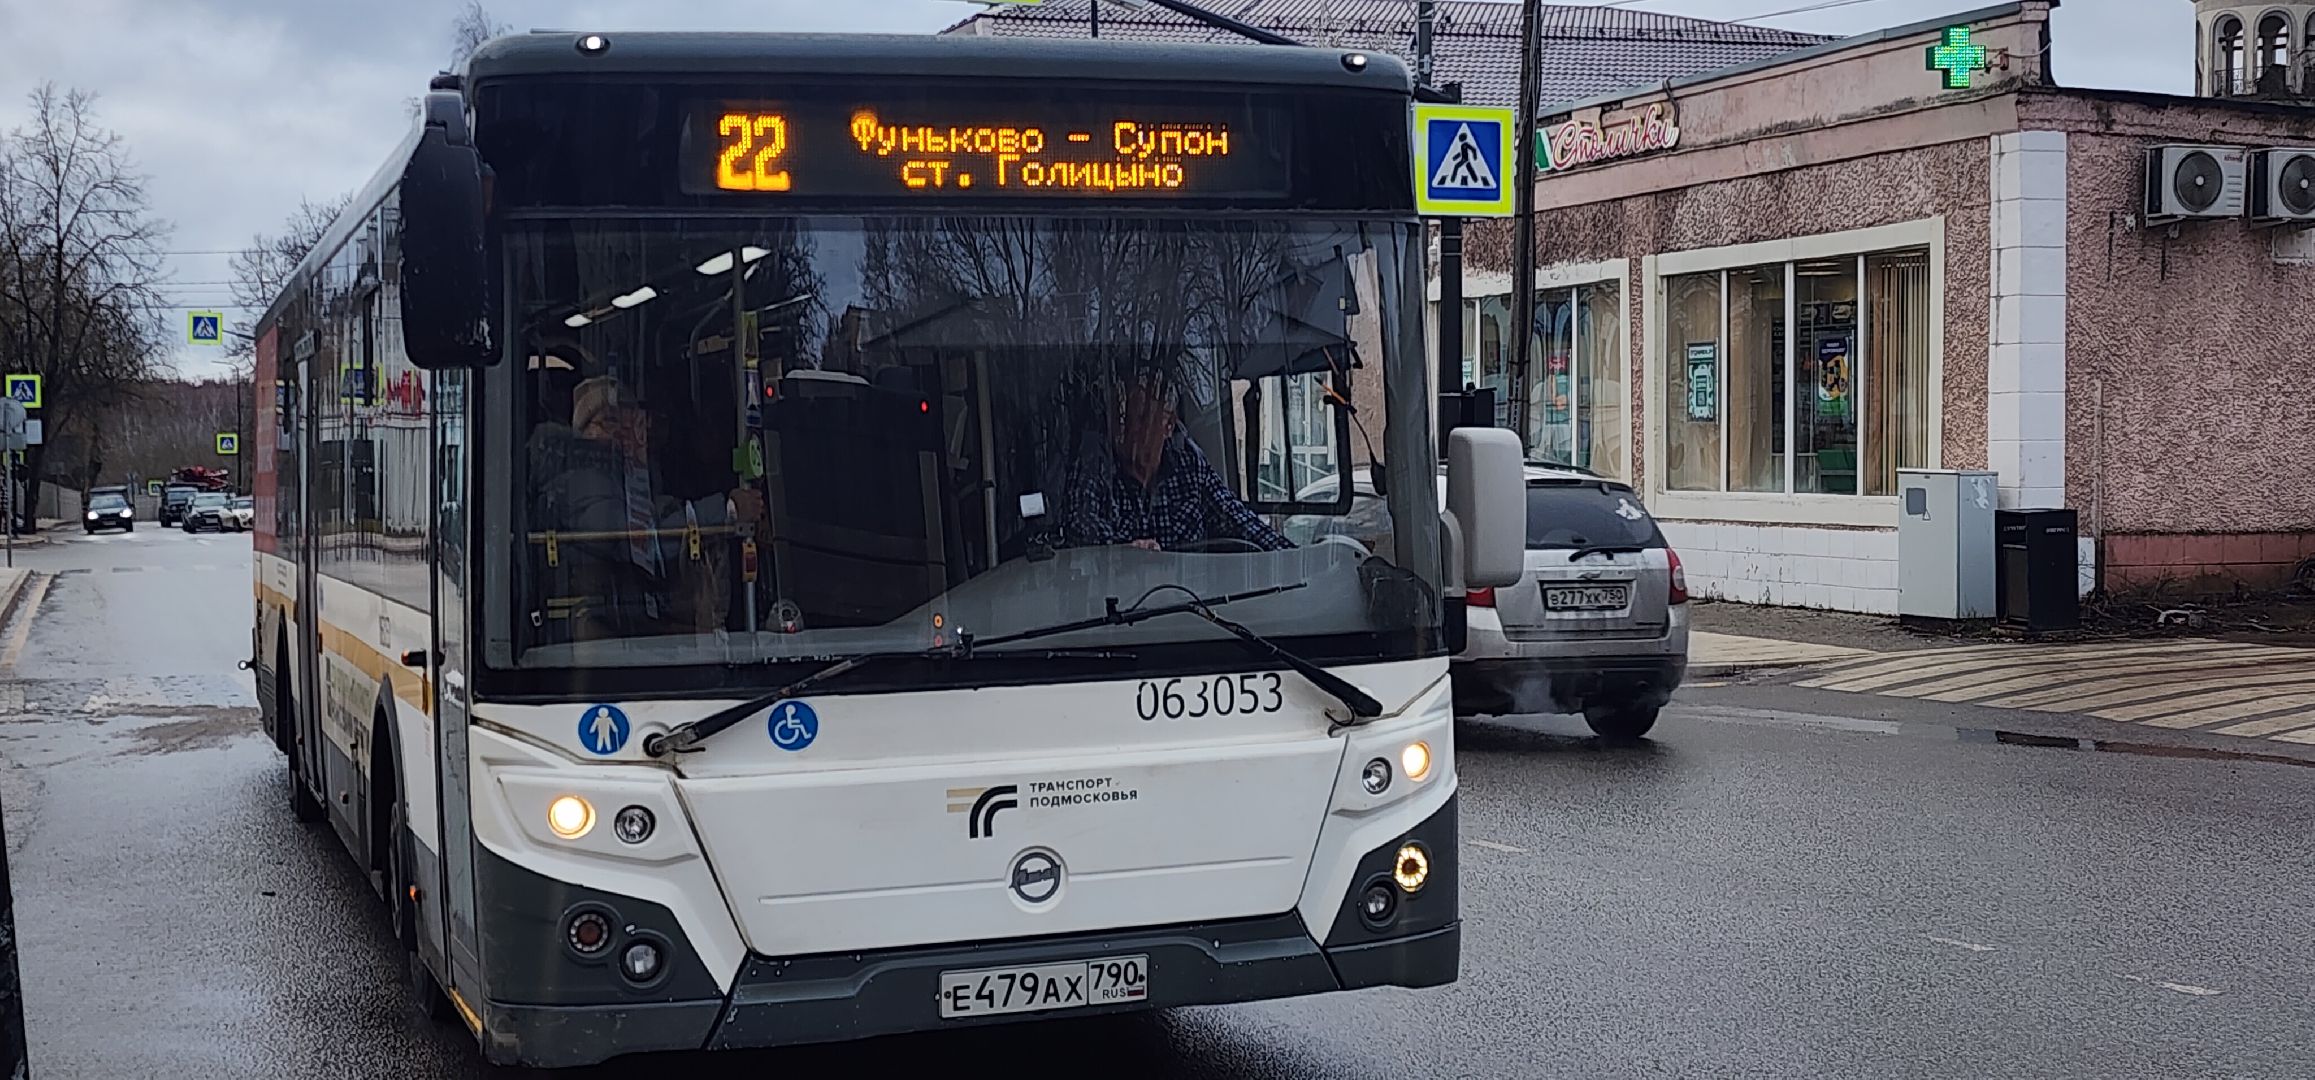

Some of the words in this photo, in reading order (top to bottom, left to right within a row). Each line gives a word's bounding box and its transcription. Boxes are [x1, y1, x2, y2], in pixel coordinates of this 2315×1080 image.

[718, 114, 790, 190] 22
[851, 115, 1043, 156] Фуньково
[1067, 133, 1090, 142] -
[1114, 121, 1228, 158] Супон
[1552, 102, 1680, 170] Столички
[902, 160, 971, 188] ст.
[998, 153, 1183, 191] Голицыно
[1136, 672, 1283, 721] 063053
[1029, 777, 1112, 793] ТРАНСПОРТ
[1030, 790, 1138, 808] ПОДМОСКОВЬЯ
[952, 972, 1083, 1011] Е479АХ
[1090, 960, 1140, 992] 790
[1102, 986, 1127, 999] RUS
